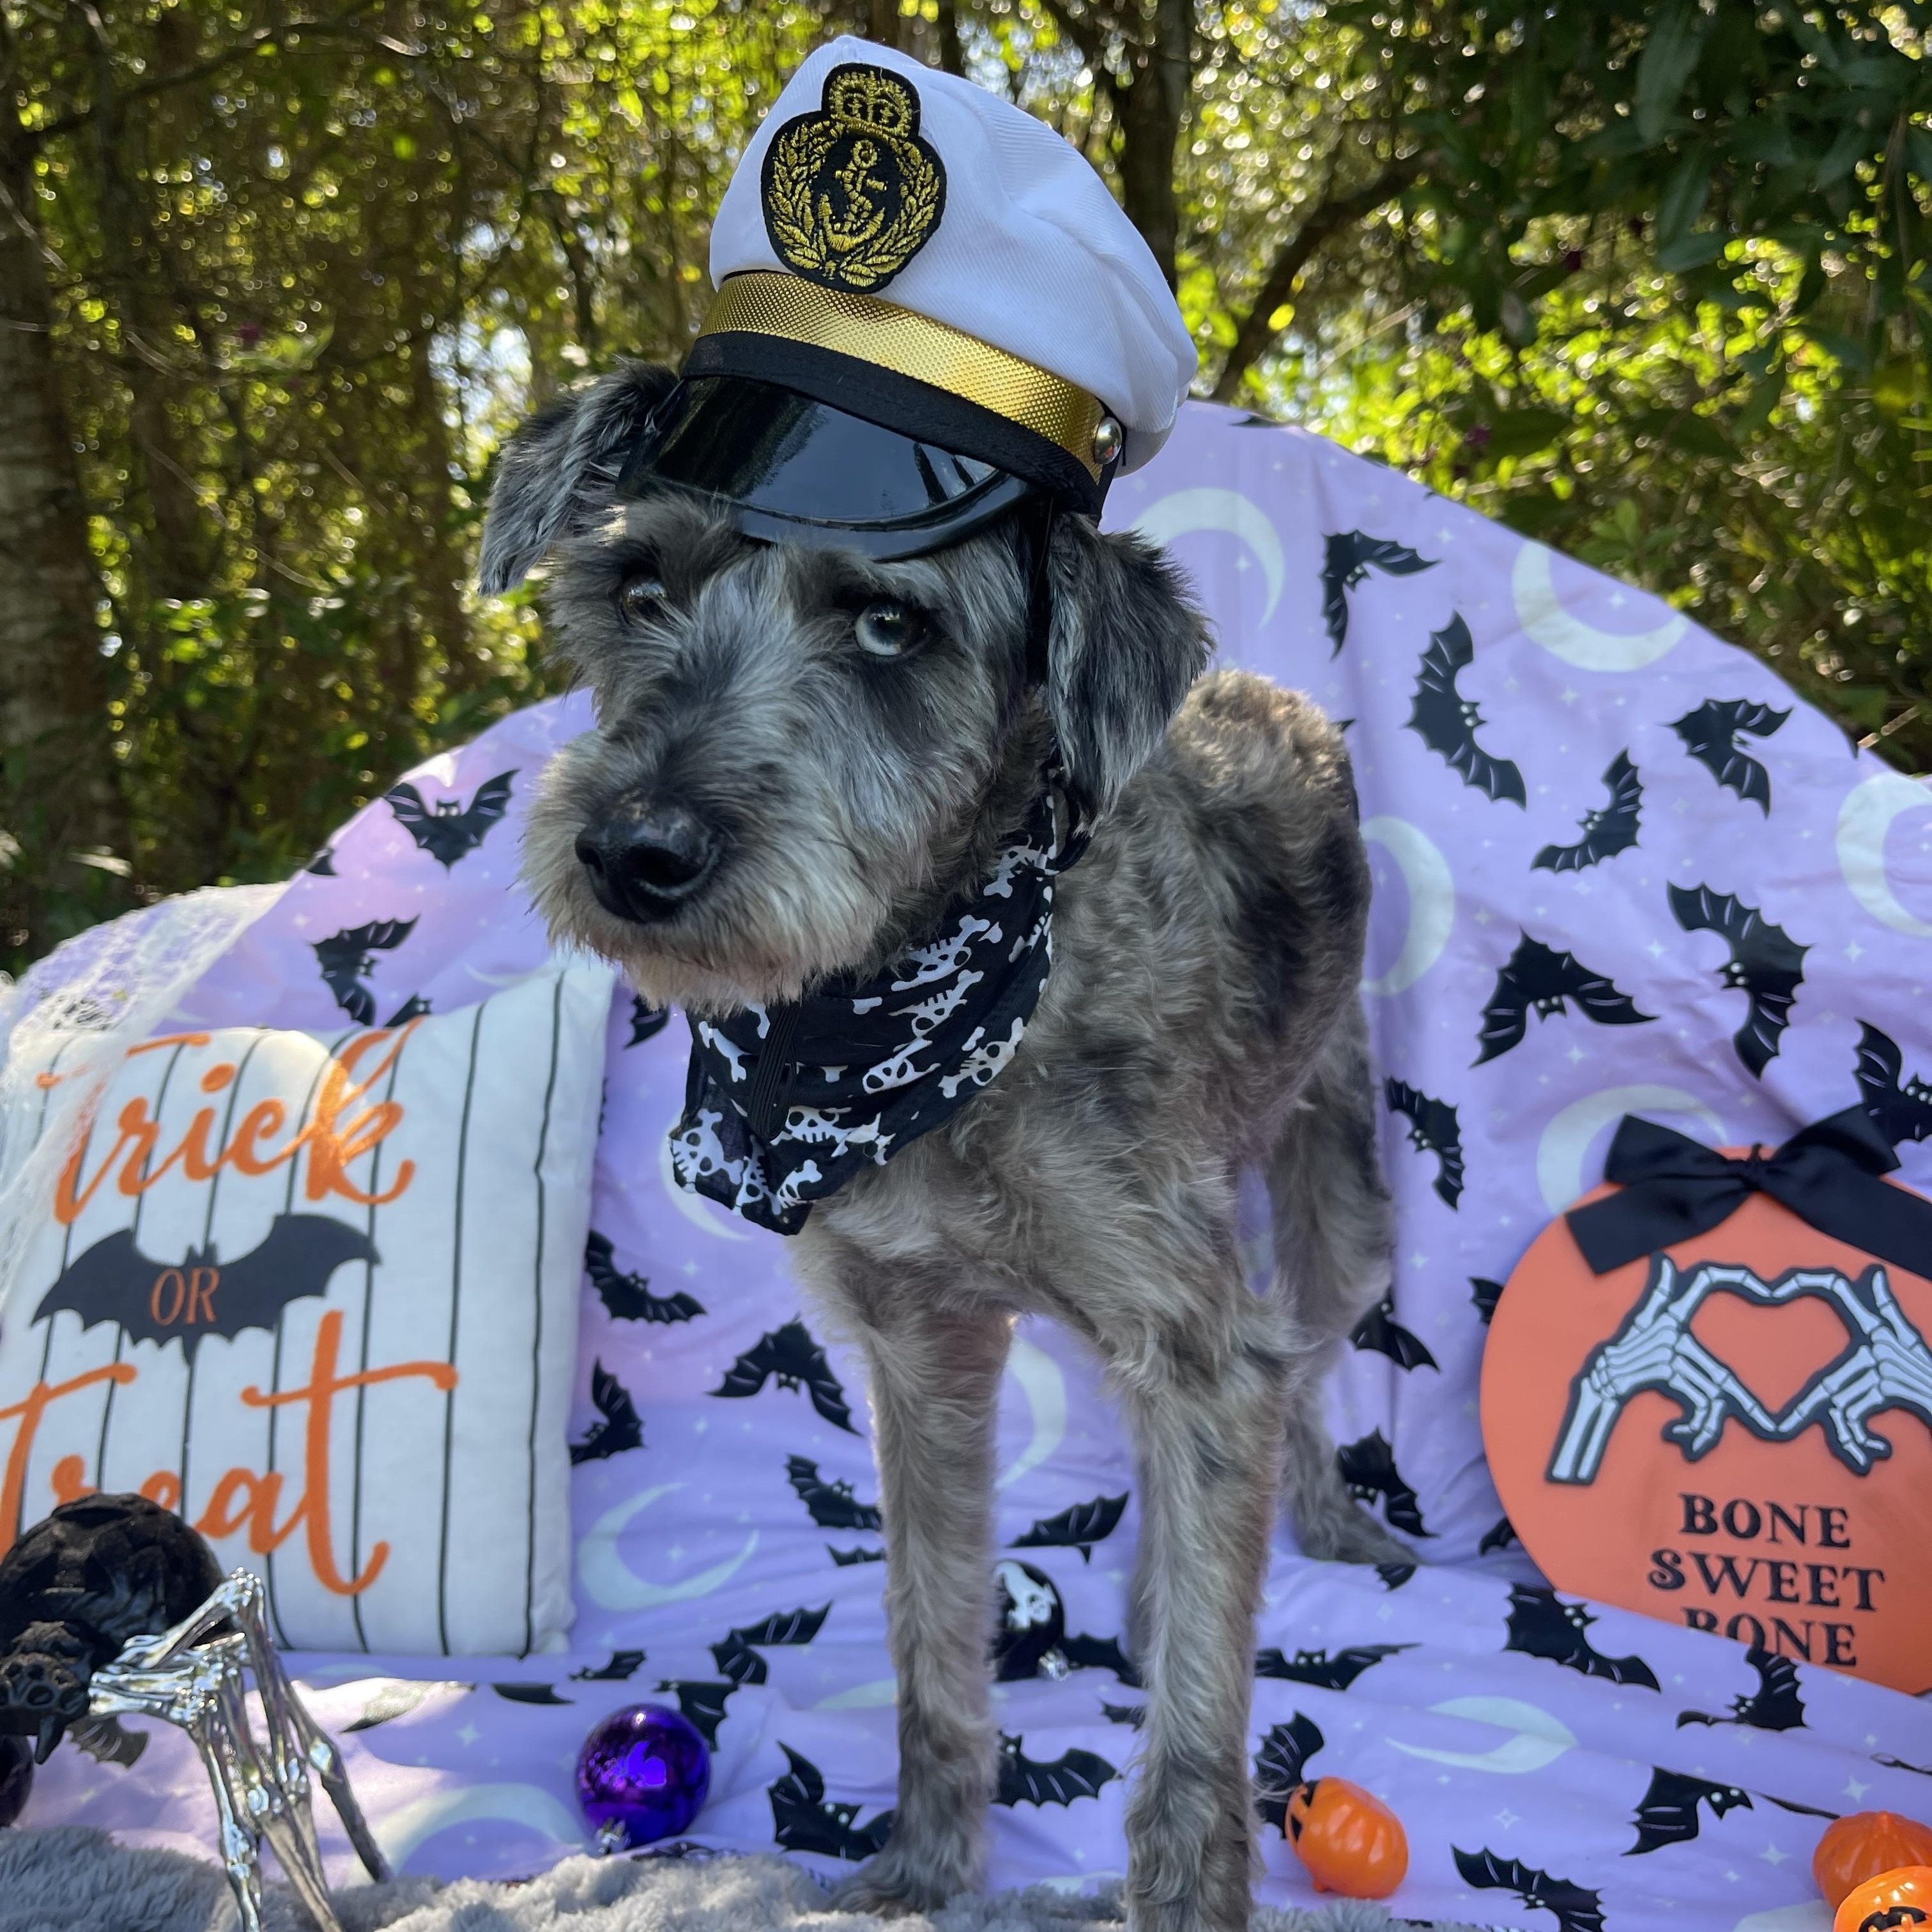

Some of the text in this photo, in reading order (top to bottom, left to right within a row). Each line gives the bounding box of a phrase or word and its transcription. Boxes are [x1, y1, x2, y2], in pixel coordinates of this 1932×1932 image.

[38, 1015, 424, 1223] Trick
[150, 1268, 220, 1325] OR
[1679, 1493, 1851, 1547] BONE
[1648, 1549, 1885, 1611] SWEET
